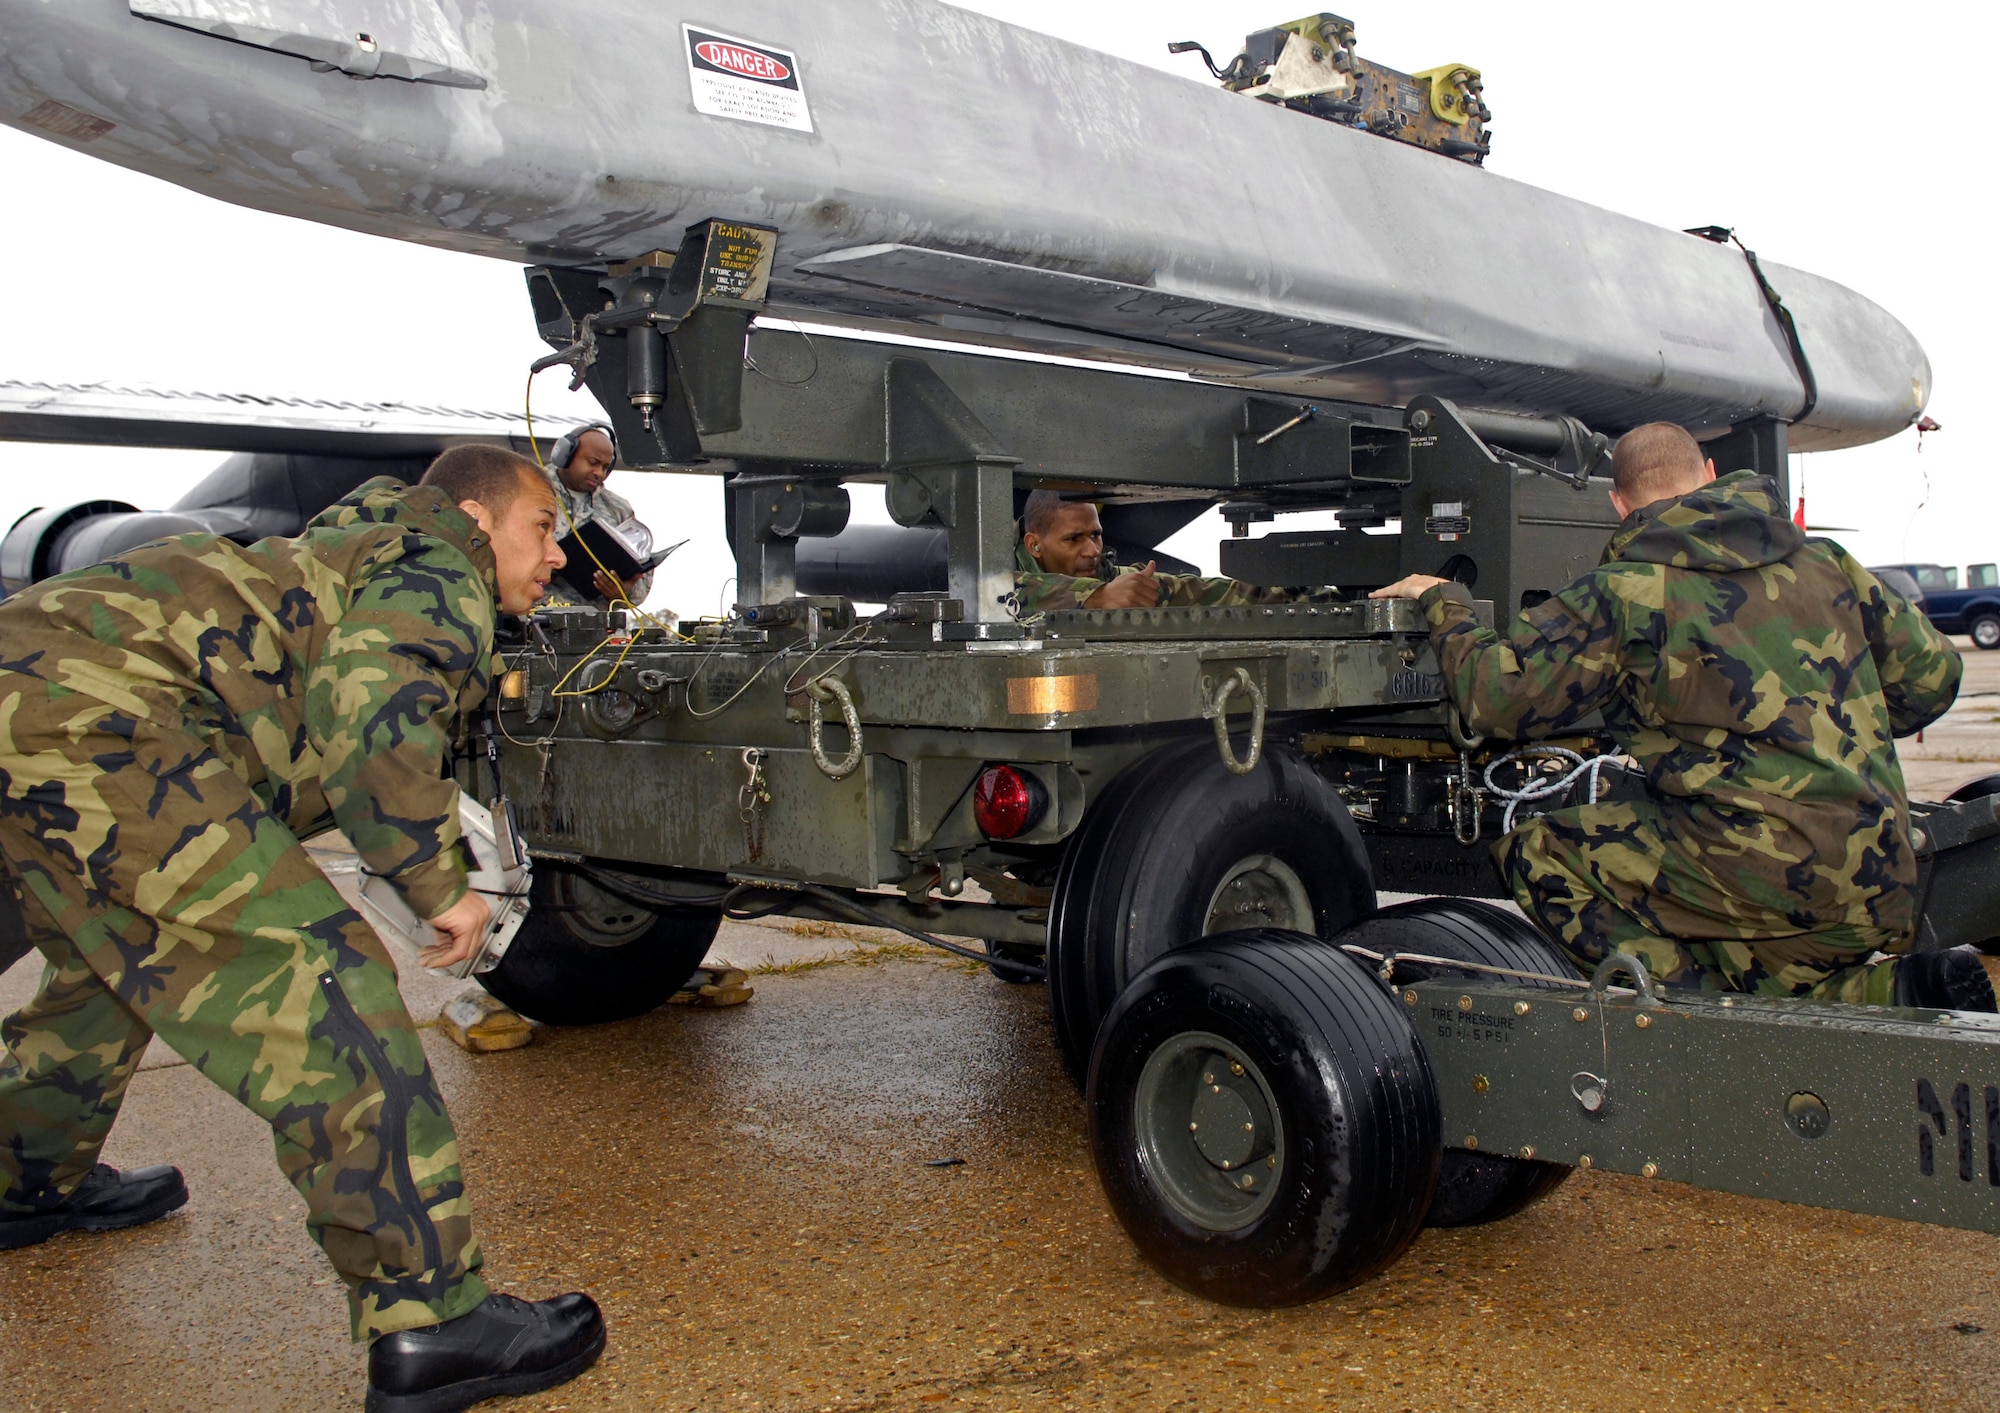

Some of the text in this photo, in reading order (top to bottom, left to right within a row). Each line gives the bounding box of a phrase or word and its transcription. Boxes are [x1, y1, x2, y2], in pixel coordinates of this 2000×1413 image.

[710, 45, 778, 78] DANGER
[699, 78, 798, 104] EXPLOSIVE ACTUATED DEVICES
[708, 95, 797, 118] FOR EXACT LOCATION AND
[719, 105, 789, 124] SAFETY PRECAUTIONS
[720, 252, 733, 260] USE
[710, 267, 747, 279] STORE AND
[716, 276, 735, 286] ONLY
[1311, 670, 1328, 688] 50
[1401, 858, 1481, 878] CAPACITY
[1430, 1007, 1515, 1030] TIRE PRESSURE
[1438, 1025, 1452, 1038] 50
